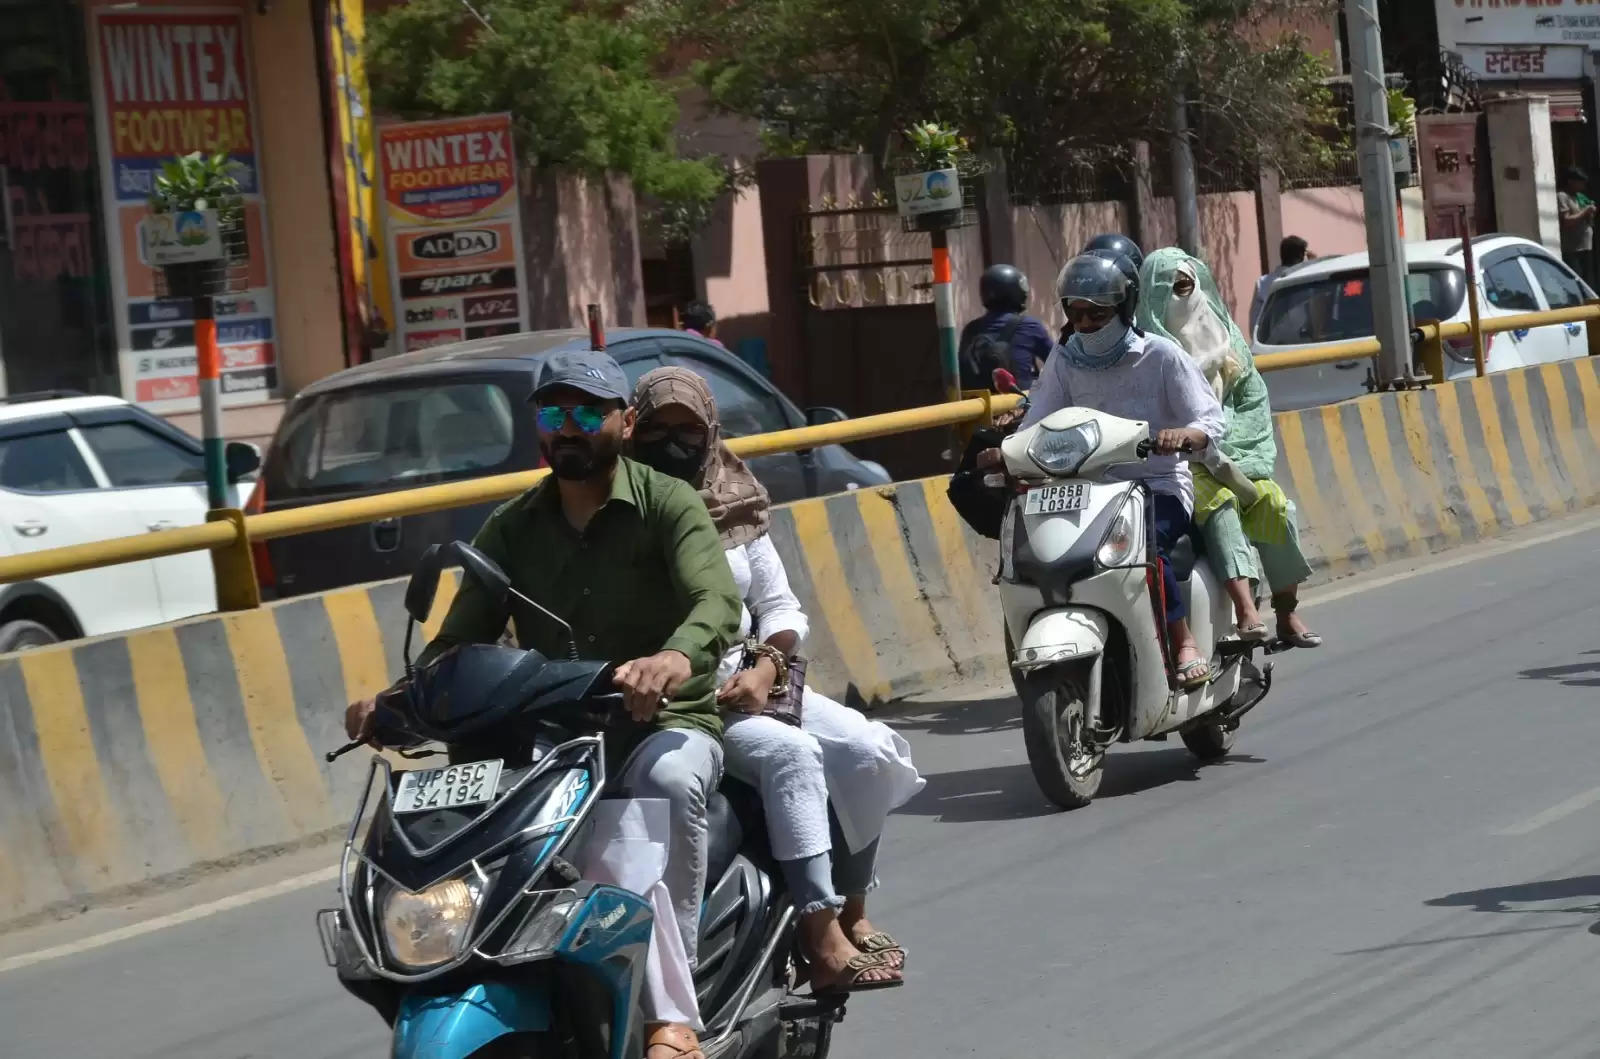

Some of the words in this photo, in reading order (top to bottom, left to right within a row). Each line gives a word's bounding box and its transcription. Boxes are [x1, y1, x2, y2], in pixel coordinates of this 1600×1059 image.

[104, 24, 243, 102] WINTEX
[114, 107, 250, 153] FOOTWEAR
[385, 130, 507, 170] WINTEX
[389, 161, 509, 190] FOOTWEAR
[422, 234, 488, 256] ADDA
[420, 269, 496, 293] sparx
[1041, 484, 1084, 501] UP65B
[416, 764, 488, 788] UP65C
[412, 784, 484, 809] S4194
